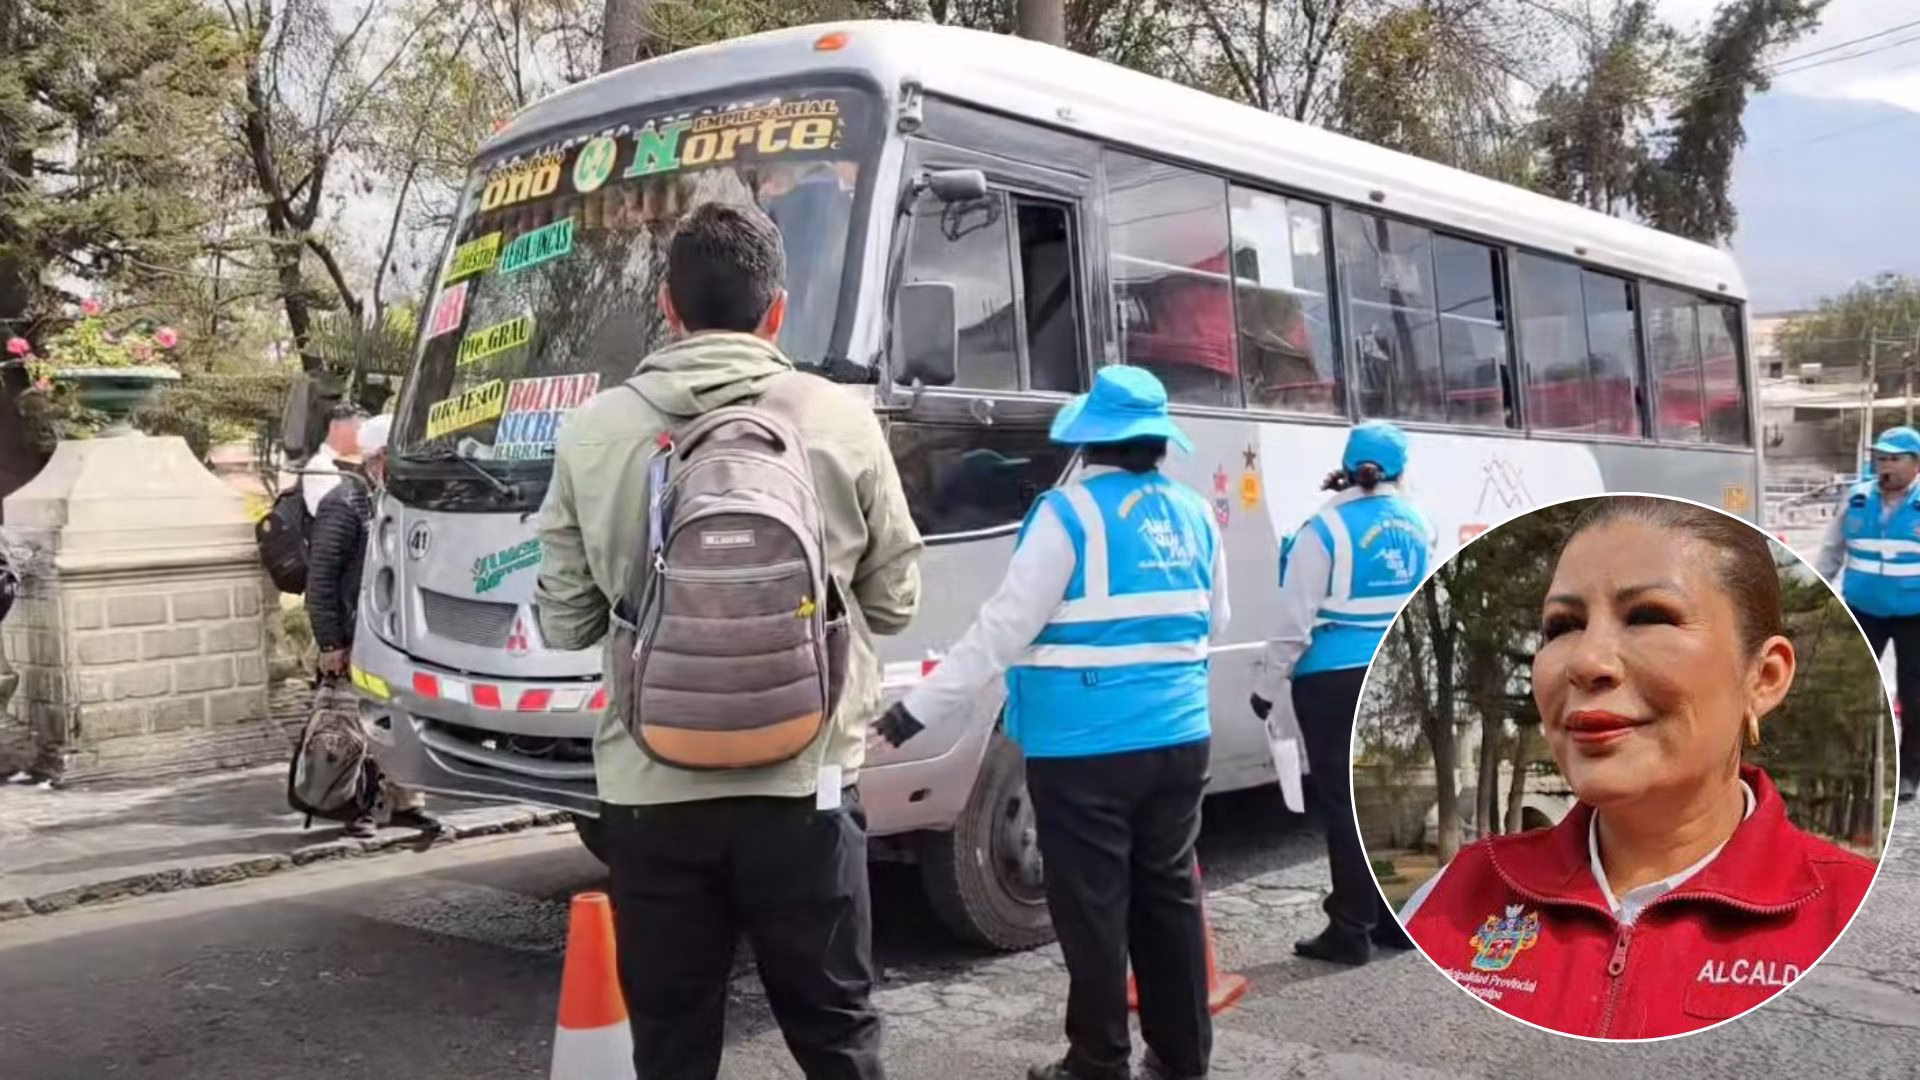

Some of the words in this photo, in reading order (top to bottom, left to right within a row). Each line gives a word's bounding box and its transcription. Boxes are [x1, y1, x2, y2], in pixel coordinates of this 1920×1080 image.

[692, 100, 838, 132] EMPRESARIAL
[623, 119, 833, 177] Norte
[411, 530, 427, 550] 41
[1489, 974, 1537, 992] Provincial
[1697, 959, 1806, 986] ALCALD
